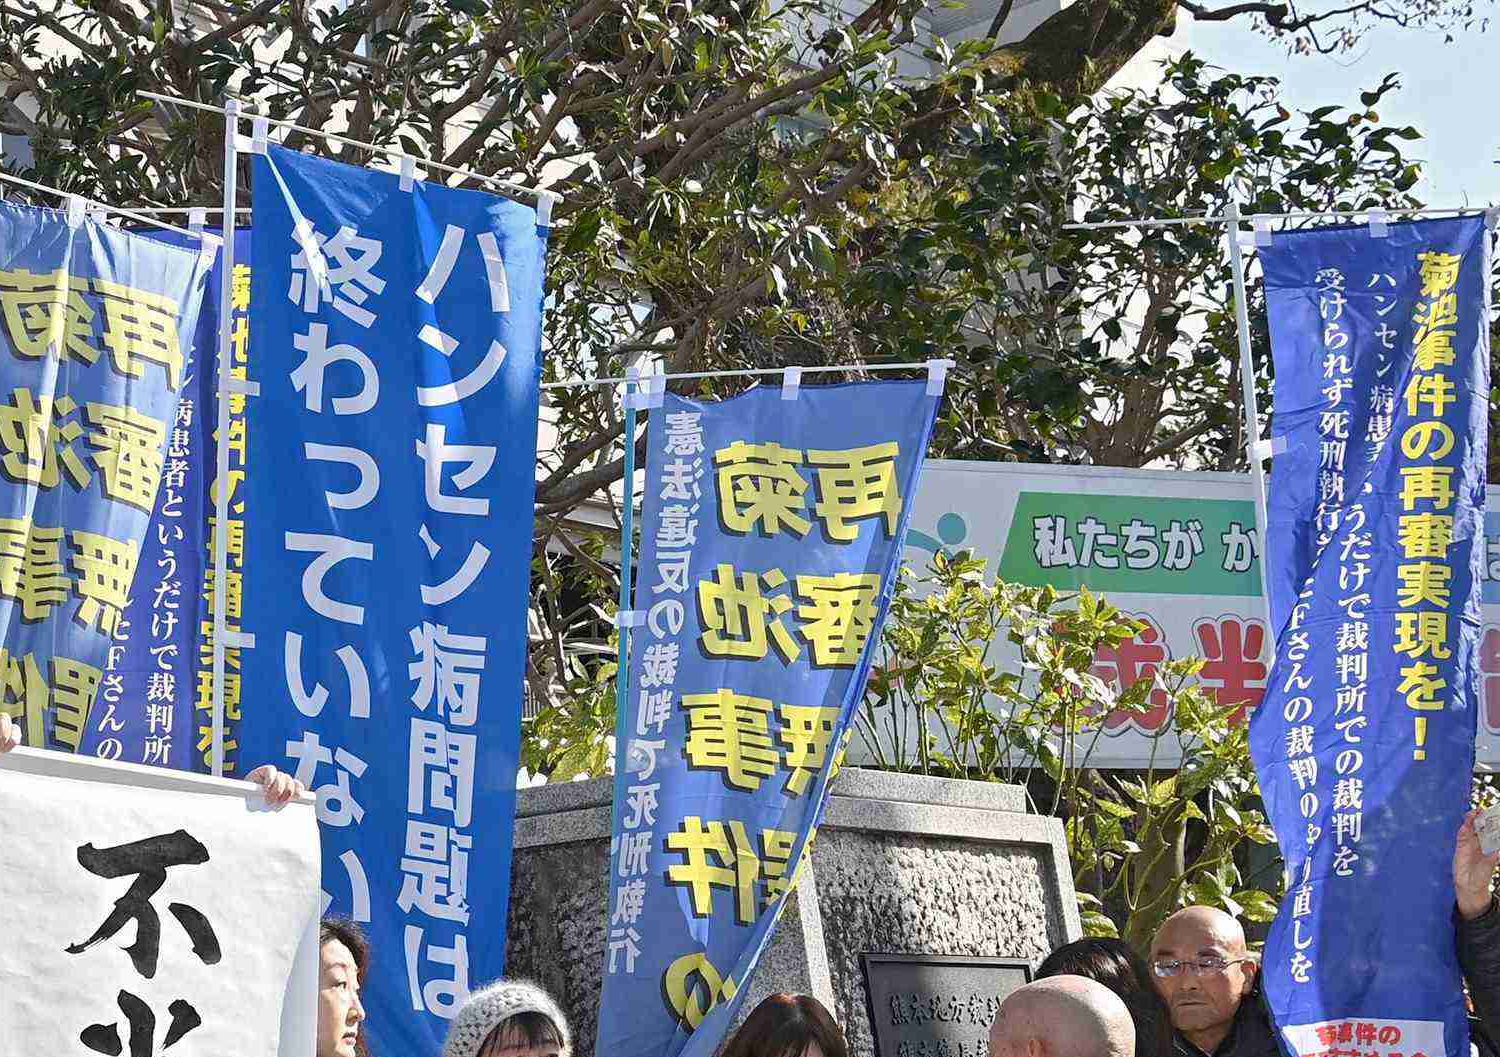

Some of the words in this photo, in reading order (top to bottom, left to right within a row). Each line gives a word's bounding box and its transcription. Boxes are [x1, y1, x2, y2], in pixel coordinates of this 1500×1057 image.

[397, 224, 510, 1018] ハンセン病問題は
[1033, 514, 1204, 571] 私たちが
[1393, 251, 1461, 761] 菊池事件の再審実現を!
